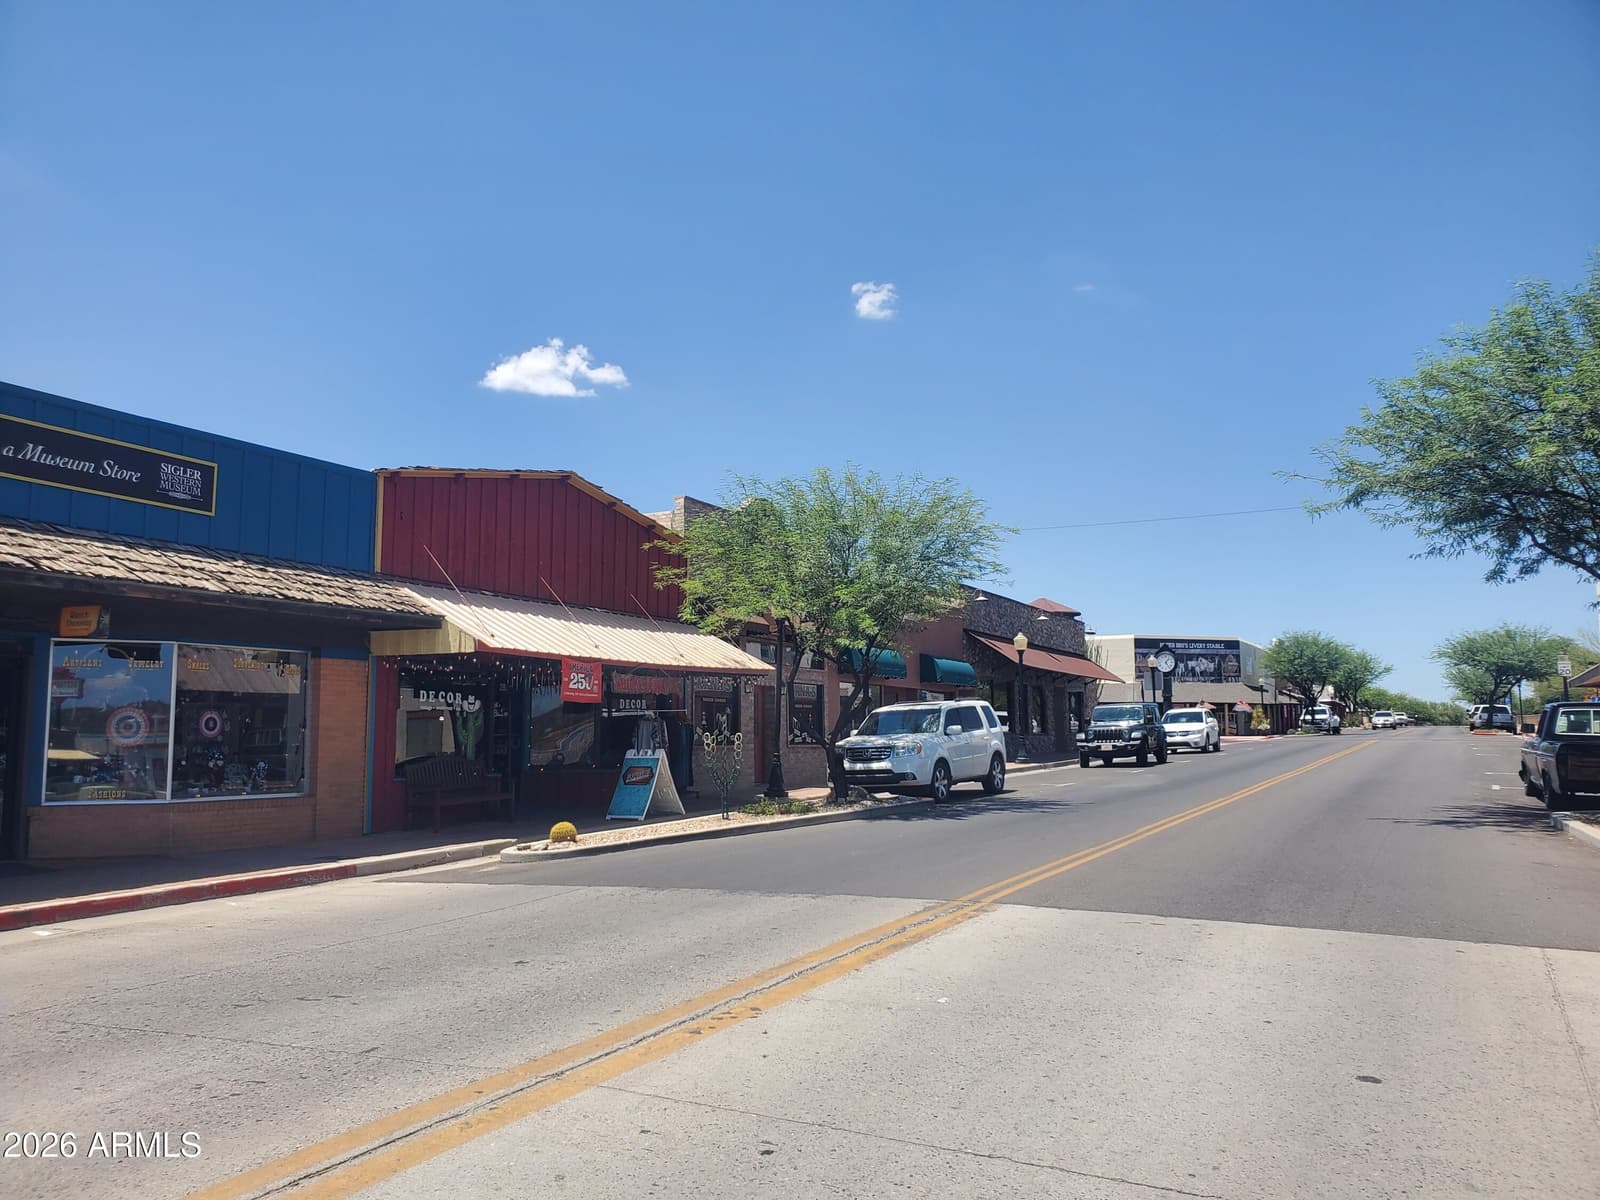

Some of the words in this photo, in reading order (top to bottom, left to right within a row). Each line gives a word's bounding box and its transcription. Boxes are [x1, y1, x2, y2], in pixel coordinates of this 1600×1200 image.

[3, 445, 14, 457] a
[18, 442, 96, 474] Museum
[99, 459, 142, 483] Store
[160, 462, 201, 480] SIGLER
[159, 480, 201, 496] MUSEUM
[160, 472, 202, 488] WESTERN
[1559, 668, 1571, 676] 20
[419, 689, 463, 705] DECOR
[619, 698, 647, 710] DECOR
